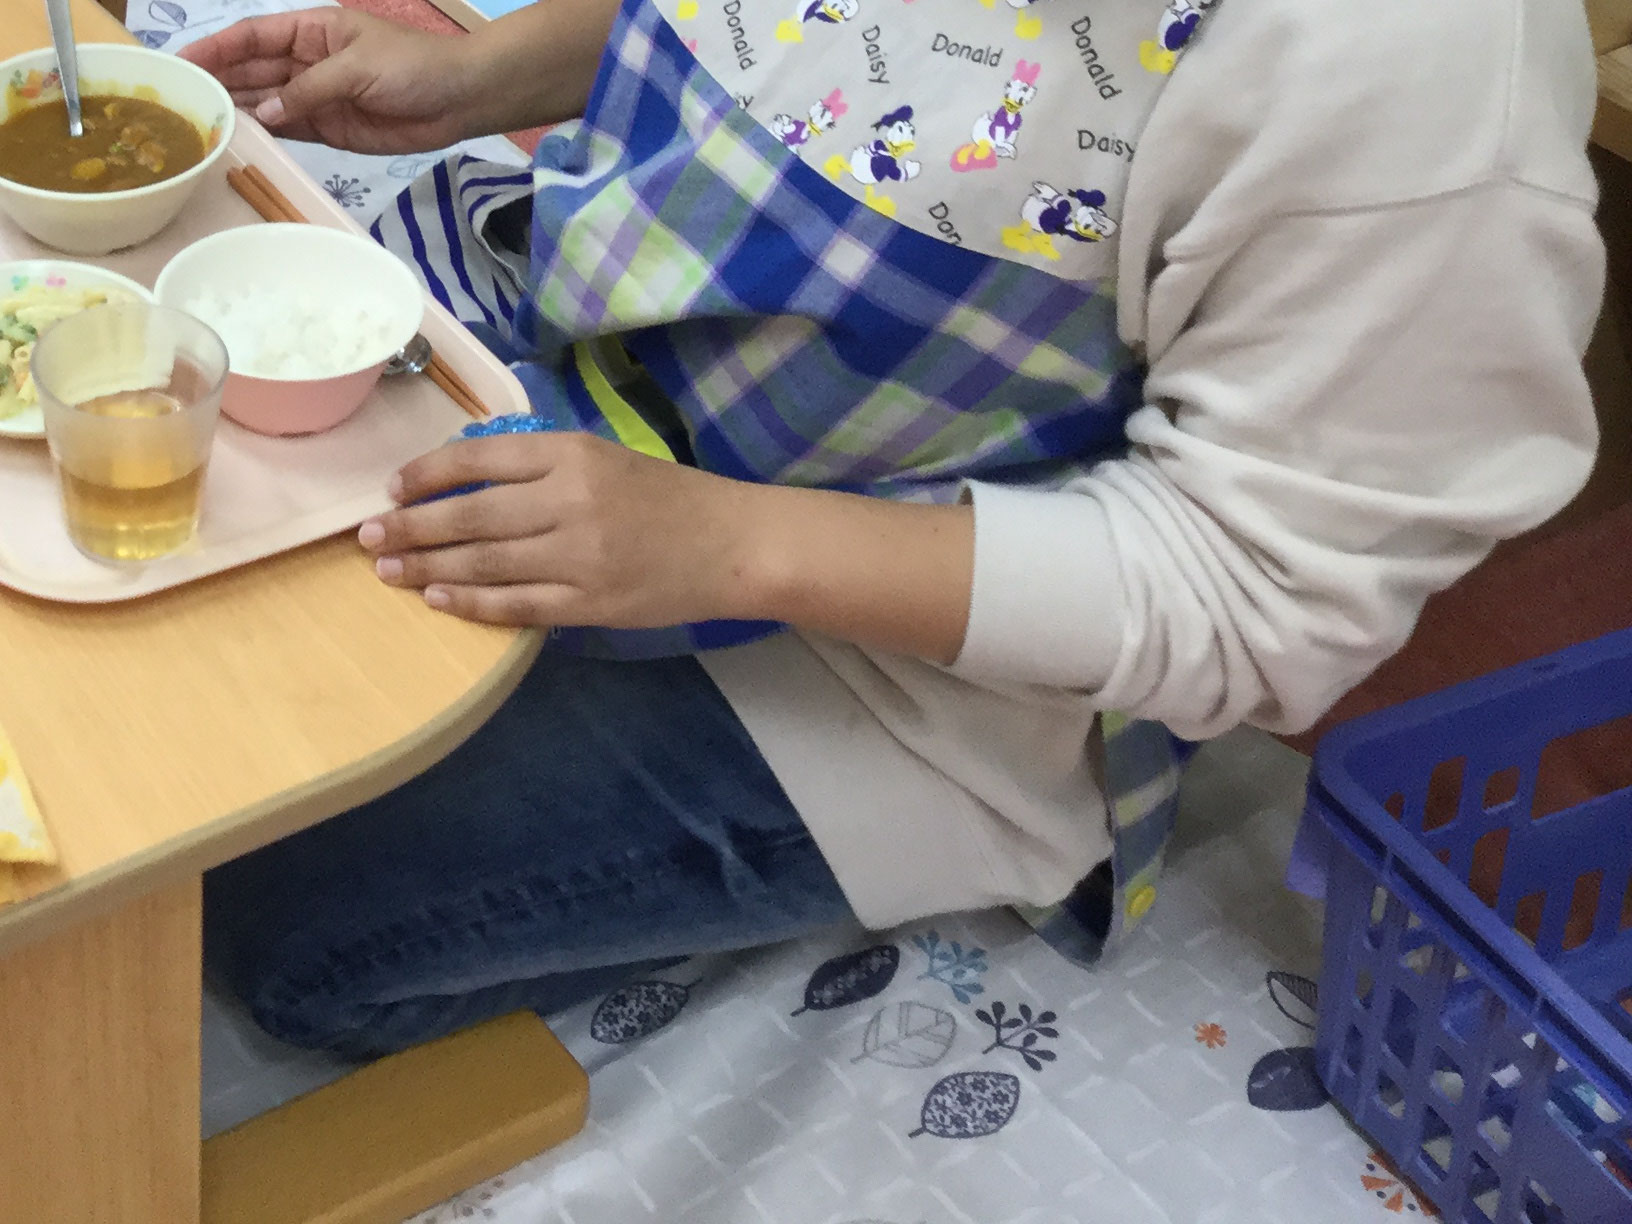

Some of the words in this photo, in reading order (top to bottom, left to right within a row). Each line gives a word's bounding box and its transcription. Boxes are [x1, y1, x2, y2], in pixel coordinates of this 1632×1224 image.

[861, 24, 891, 85] Daisy
[930, 32, 1004, 68] Donald
[1069, 15, 1123, 101] Donald
[1077, 129, 1136, 163] Daisy
